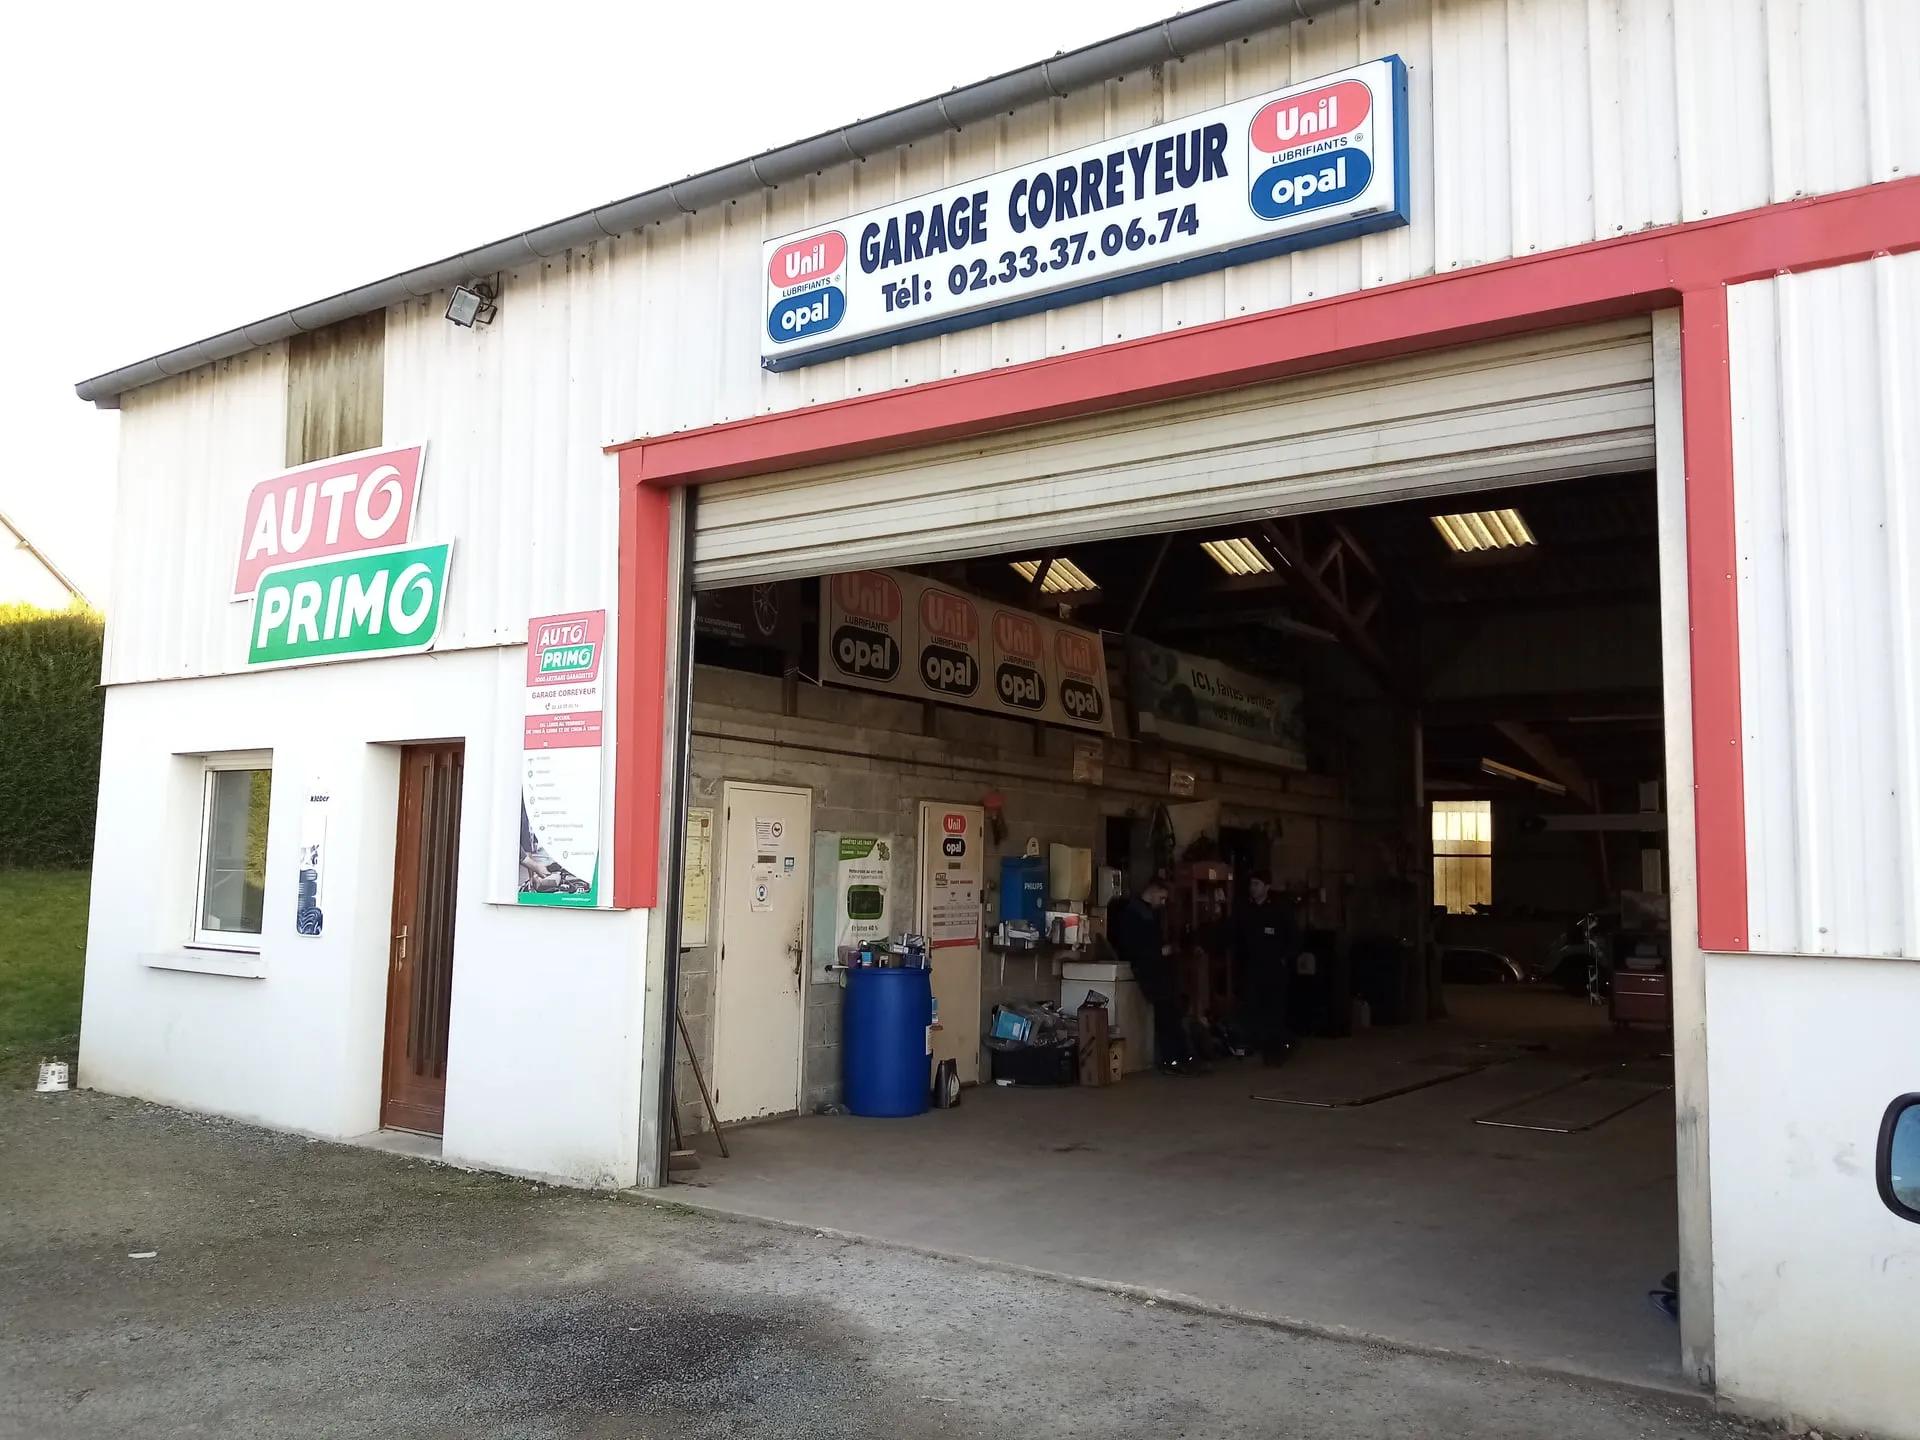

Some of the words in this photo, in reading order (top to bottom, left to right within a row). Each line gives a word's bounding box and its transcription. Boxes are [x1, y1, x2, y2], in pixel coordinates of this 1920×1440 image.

[1276, 95, 1338, 141] Unil
[1272, 137, 1348, 164] LUBRIFIANTS
[859, 190, 988, 274] GARAGE
[1008, 122, 1229, 234] CORREYEUR
[1271, 156, 1347, 206] opal
[785, 243, 825, 279] Unil
[948, 203, 1199, 295] 02.33.37.06.74
[782, 277, 831, 297] LUBRIFIANTS
[781, 293, 830, 332] opal
[246, 464, 403, 561] AUTO
[256, 562, 434, 649] PRIMO
[840, 573, 889, 617] Unil
[844, 615, 889, 632] LUBRIFIANTS
[928, 594, 967, 637] Unil
[540, 625, 583, 646] AUTO
[931, 636, 969, 651] LUBRIFIANTS
[1000, 615, 1033, 657] Unil
[543, 648, 591, 669] PRIMO
[839, 637, 891, 672] opal
[1060, 635, 1089, 671] Unil
[926, 656, 971, 689] opal
[1001, 672, 1040, 704] opal
[531, 690, 557, 699] GARAGE
[1065, 687, 1099, 717] opal
[947, 817, 961, 830] Unil
[946, 840, 962, 855] opal
[1024, 882, 1044, 890] PHILIPS
